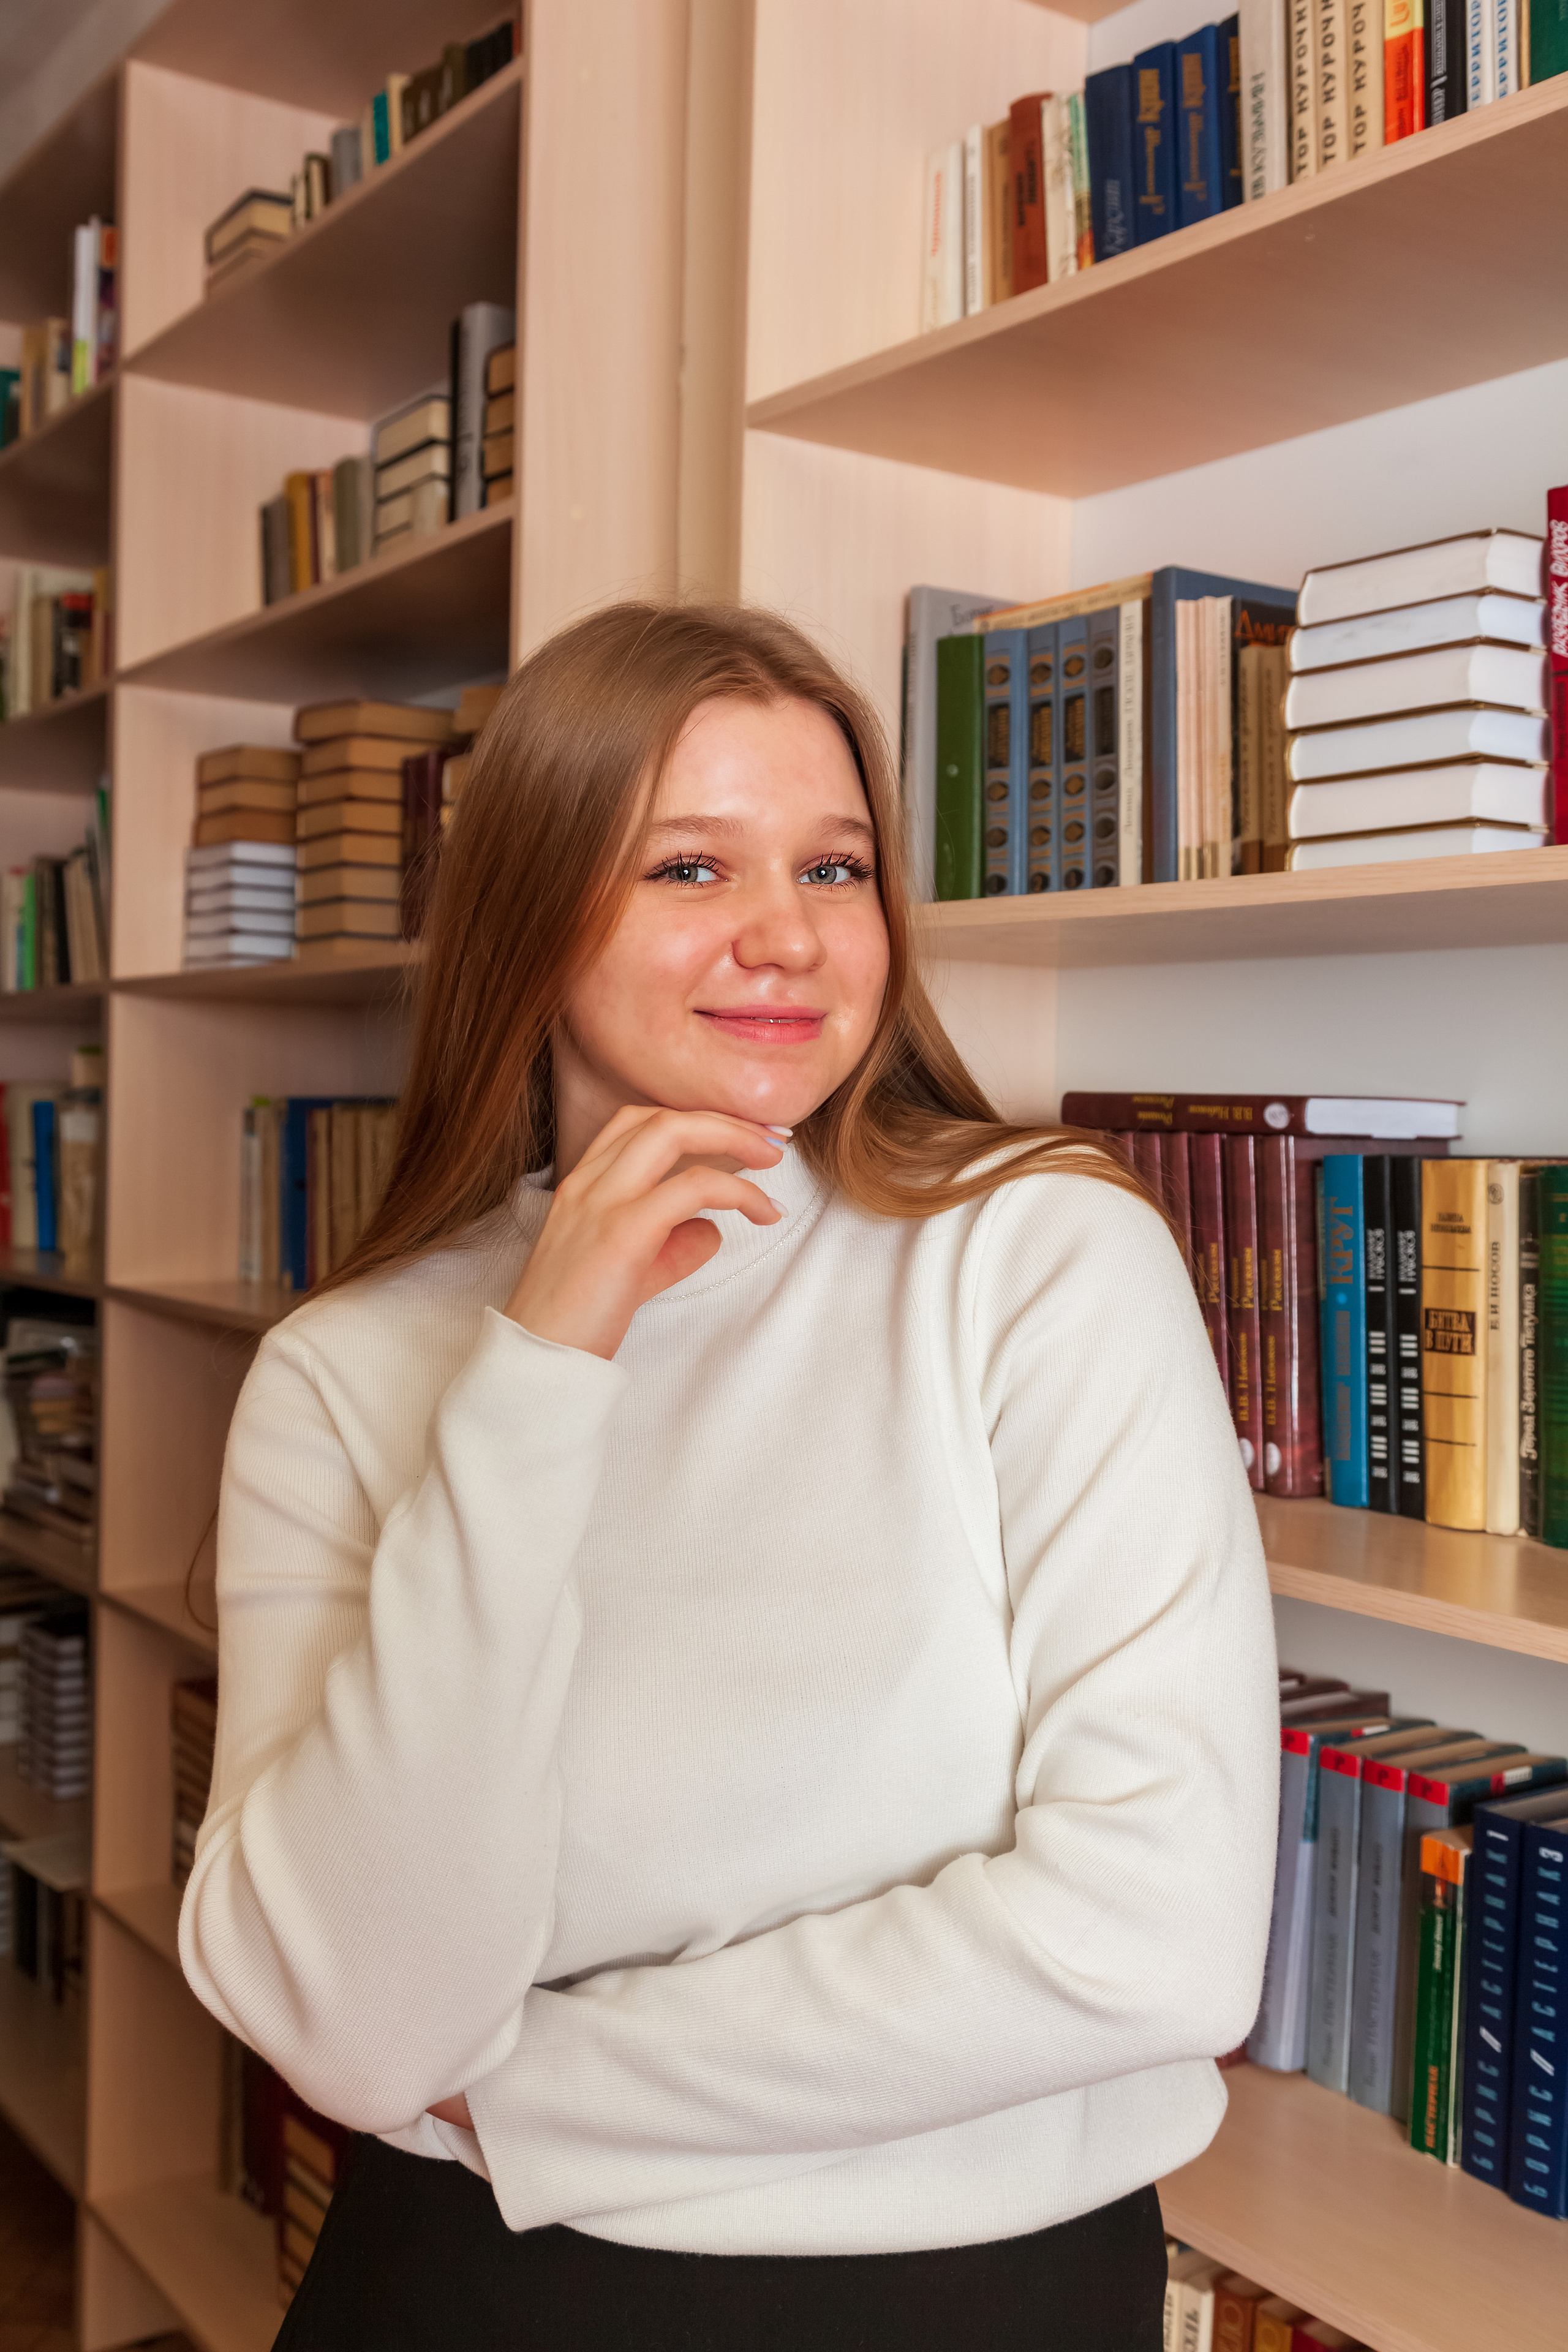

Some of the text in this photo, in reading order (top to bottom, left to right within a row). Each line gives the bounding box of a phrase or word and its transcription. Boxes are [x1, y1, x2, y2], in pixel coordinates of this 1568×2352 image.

[1330, 1196, 1354, 1285] КРУГ
[1471, 2059, 1499, 2172] БОРИС
[1523, 2083, 1554, 2199] БОРИС
